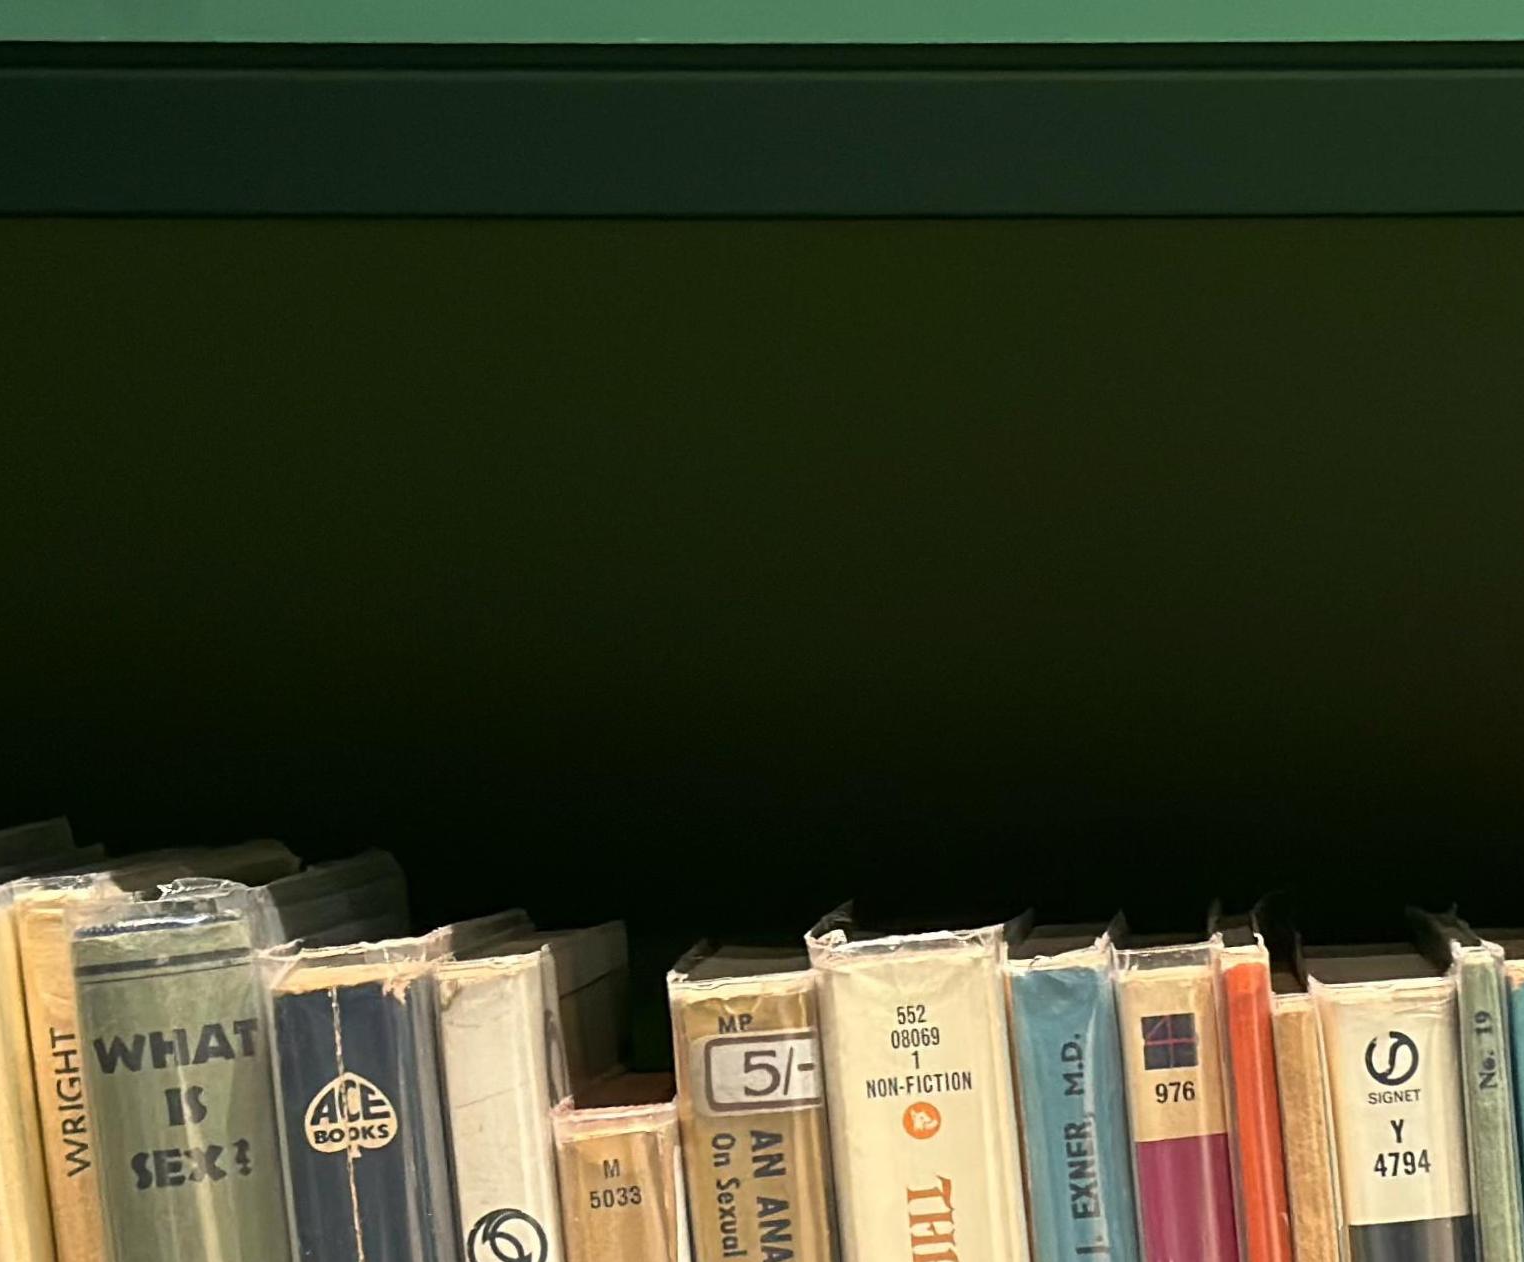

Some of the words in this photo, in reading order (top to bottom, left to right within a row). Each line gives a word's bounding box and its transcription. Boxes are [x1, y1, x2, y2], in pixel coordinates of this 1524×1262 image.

[717, 1012, 752, 1034] MP
[896, 1005, 927, 1024] 552
[1474, 1009, 1491, 1038] 19
[890, 1026, 940, 1049] 08069
[866, 1073, 972, 1095] NON-FICTION
[1155, 1081, 1195, 1103] 976
[1368, 1089, 1421, 1104] SIGNET
[1390, 1120, 1405, 1144] Y
[602, 1159, 620, 1178] M
[1374, 1151, 1430, 1178] 4794
[589, 1184, 642, 1209] 5033
